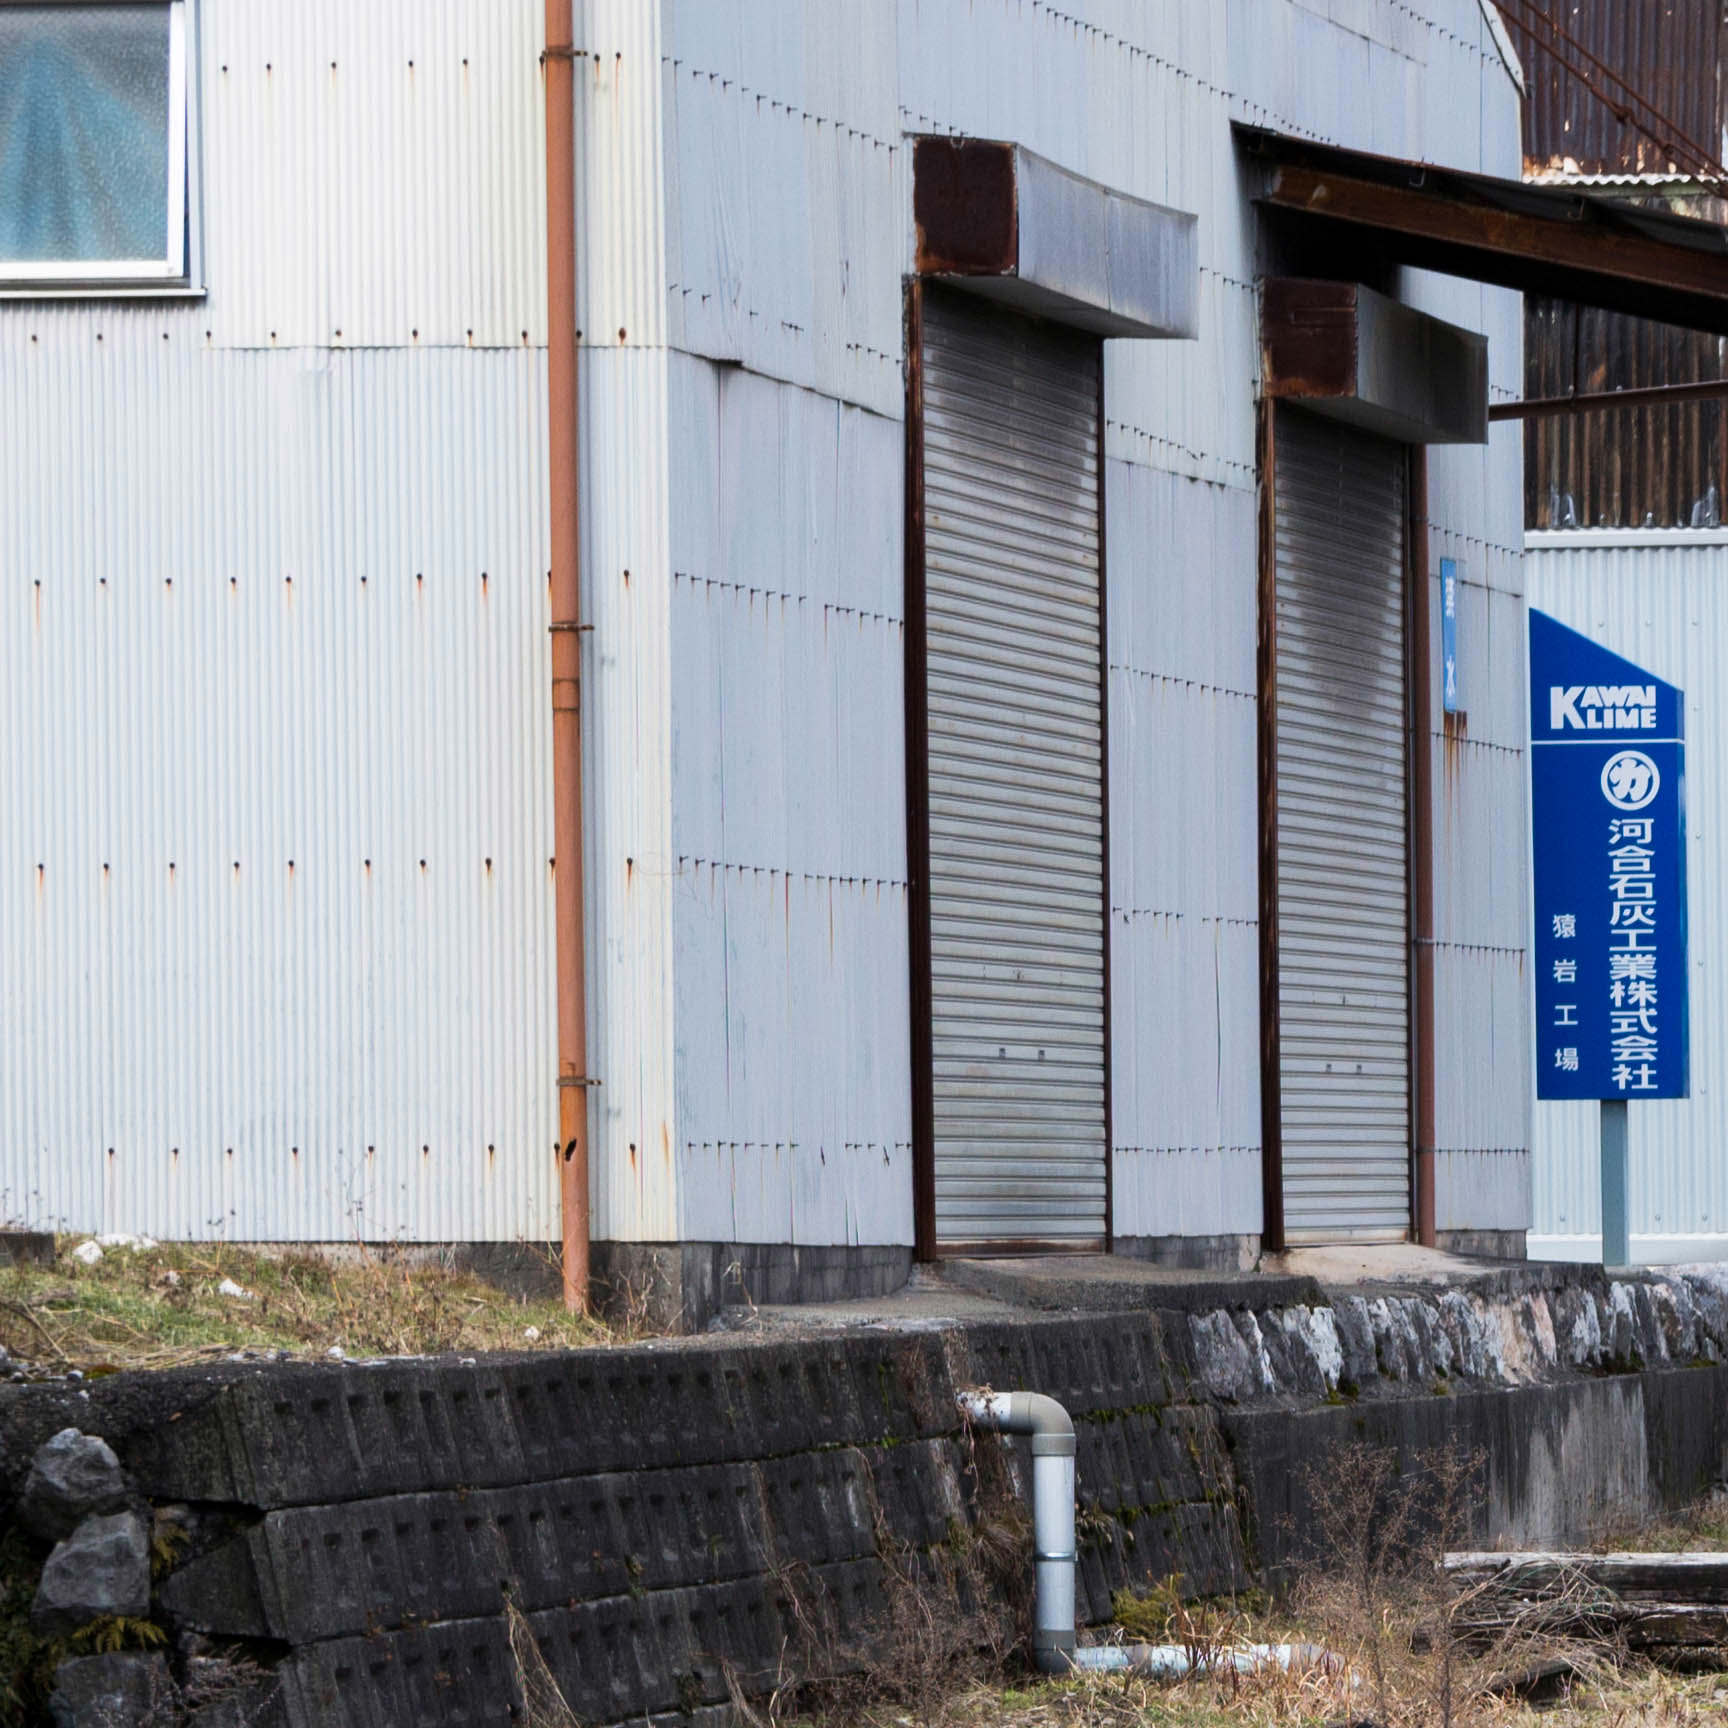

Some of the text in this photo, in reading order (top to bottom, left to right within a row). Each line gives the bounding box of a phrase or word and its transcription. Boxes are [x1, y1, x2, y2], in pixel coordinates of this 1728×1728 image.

[1552, 913, 1580, 1072] 猿岩工場
[1607, 817, 1659, 1090] 河合石灰工業株式会社
